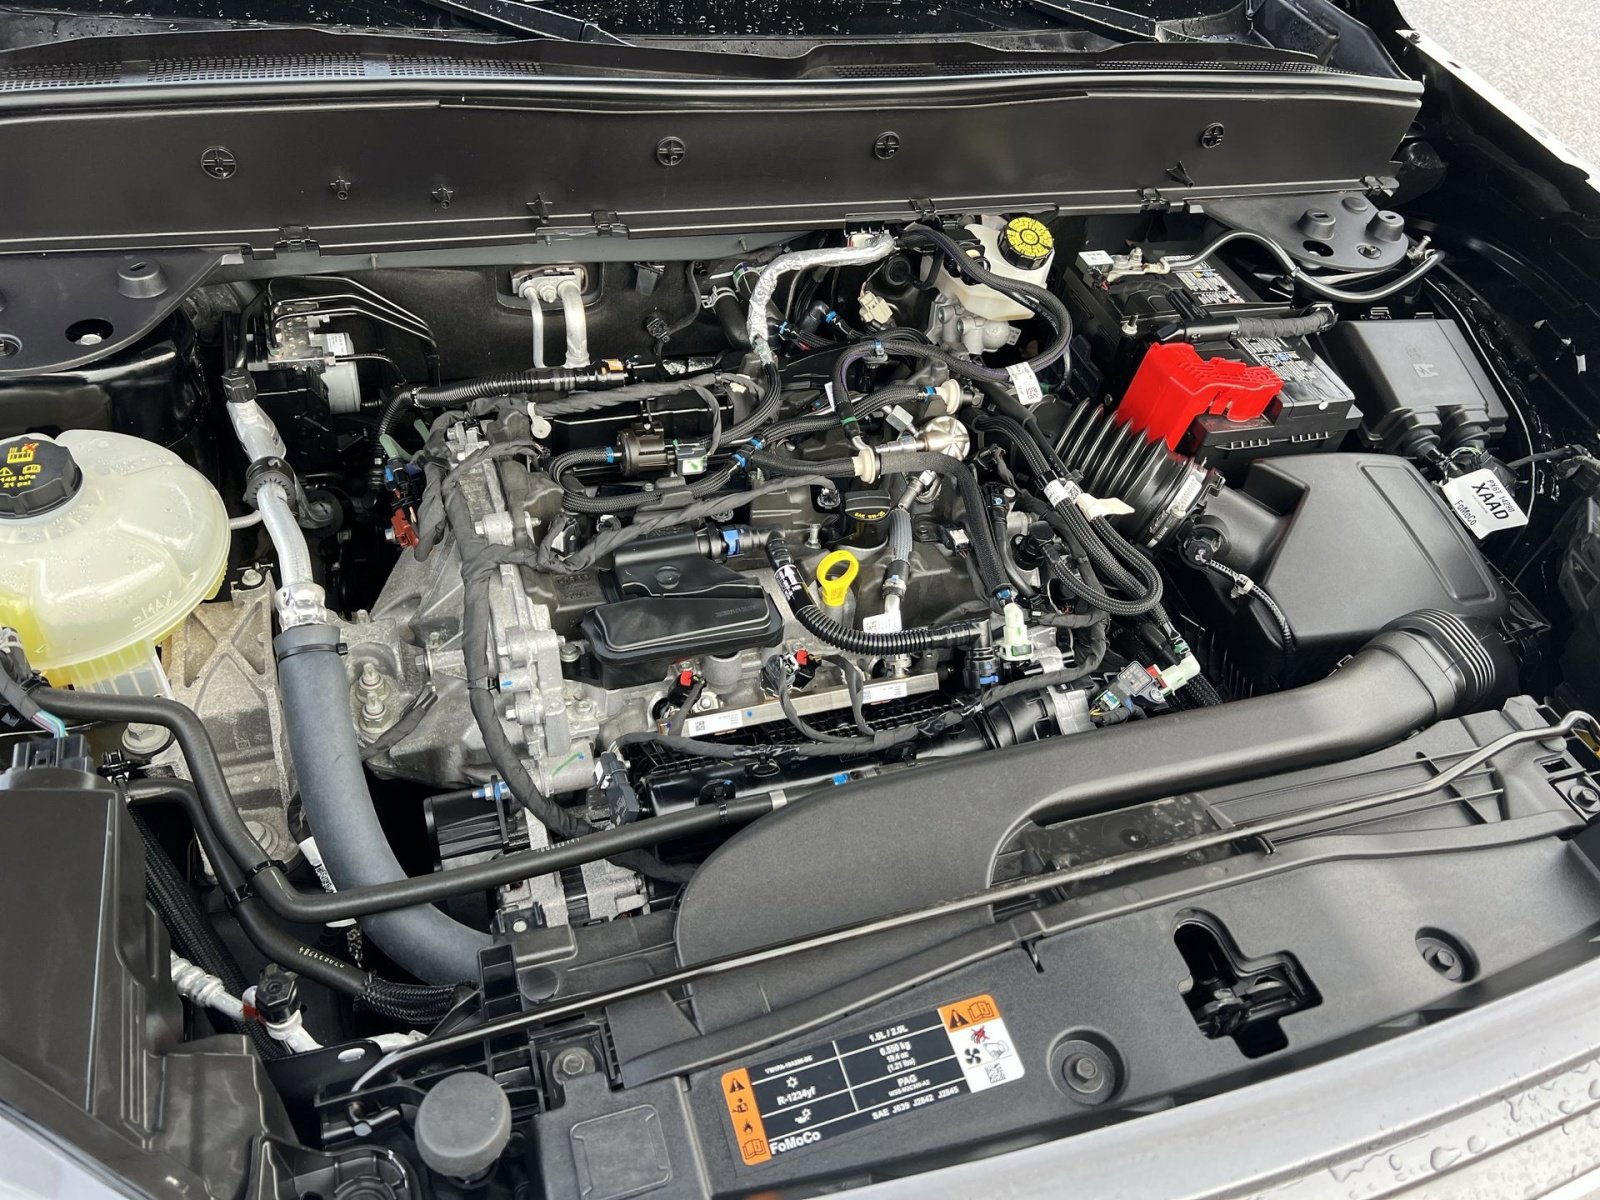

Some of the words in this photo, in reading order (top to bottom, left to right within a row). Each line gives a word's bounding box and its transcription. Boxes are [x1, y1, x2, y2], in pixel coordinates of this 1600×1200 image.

[1472, 482, 1509, 519] XAAD
[1454, 500, 1477, 525] FoMoCo
[869, 1031, 887, 1042] 1.5L
[891, 1025, 909, 1036] 2.0L
[879, 1043, 900, 1056] 0.550
[900, 1041, 912, 1050] kg
[886, 1054, 900, 1063] 19.4
[887, 1061, 902, 1073] (1.21
[902, 1057, 916, 1069] lbs)
[897, 1074, 918, 1087] PAG
[777, 1086, 816, 1105] R-1234yf
[872, 1108, 890, 1120] SAE
[892, 1102, 910, 1114] J639
[912, 1094, 935, 1107] J2842
[937, 1086, 960, 1099] J2845
[770, 1131, 821, 1155] FoMoCo
